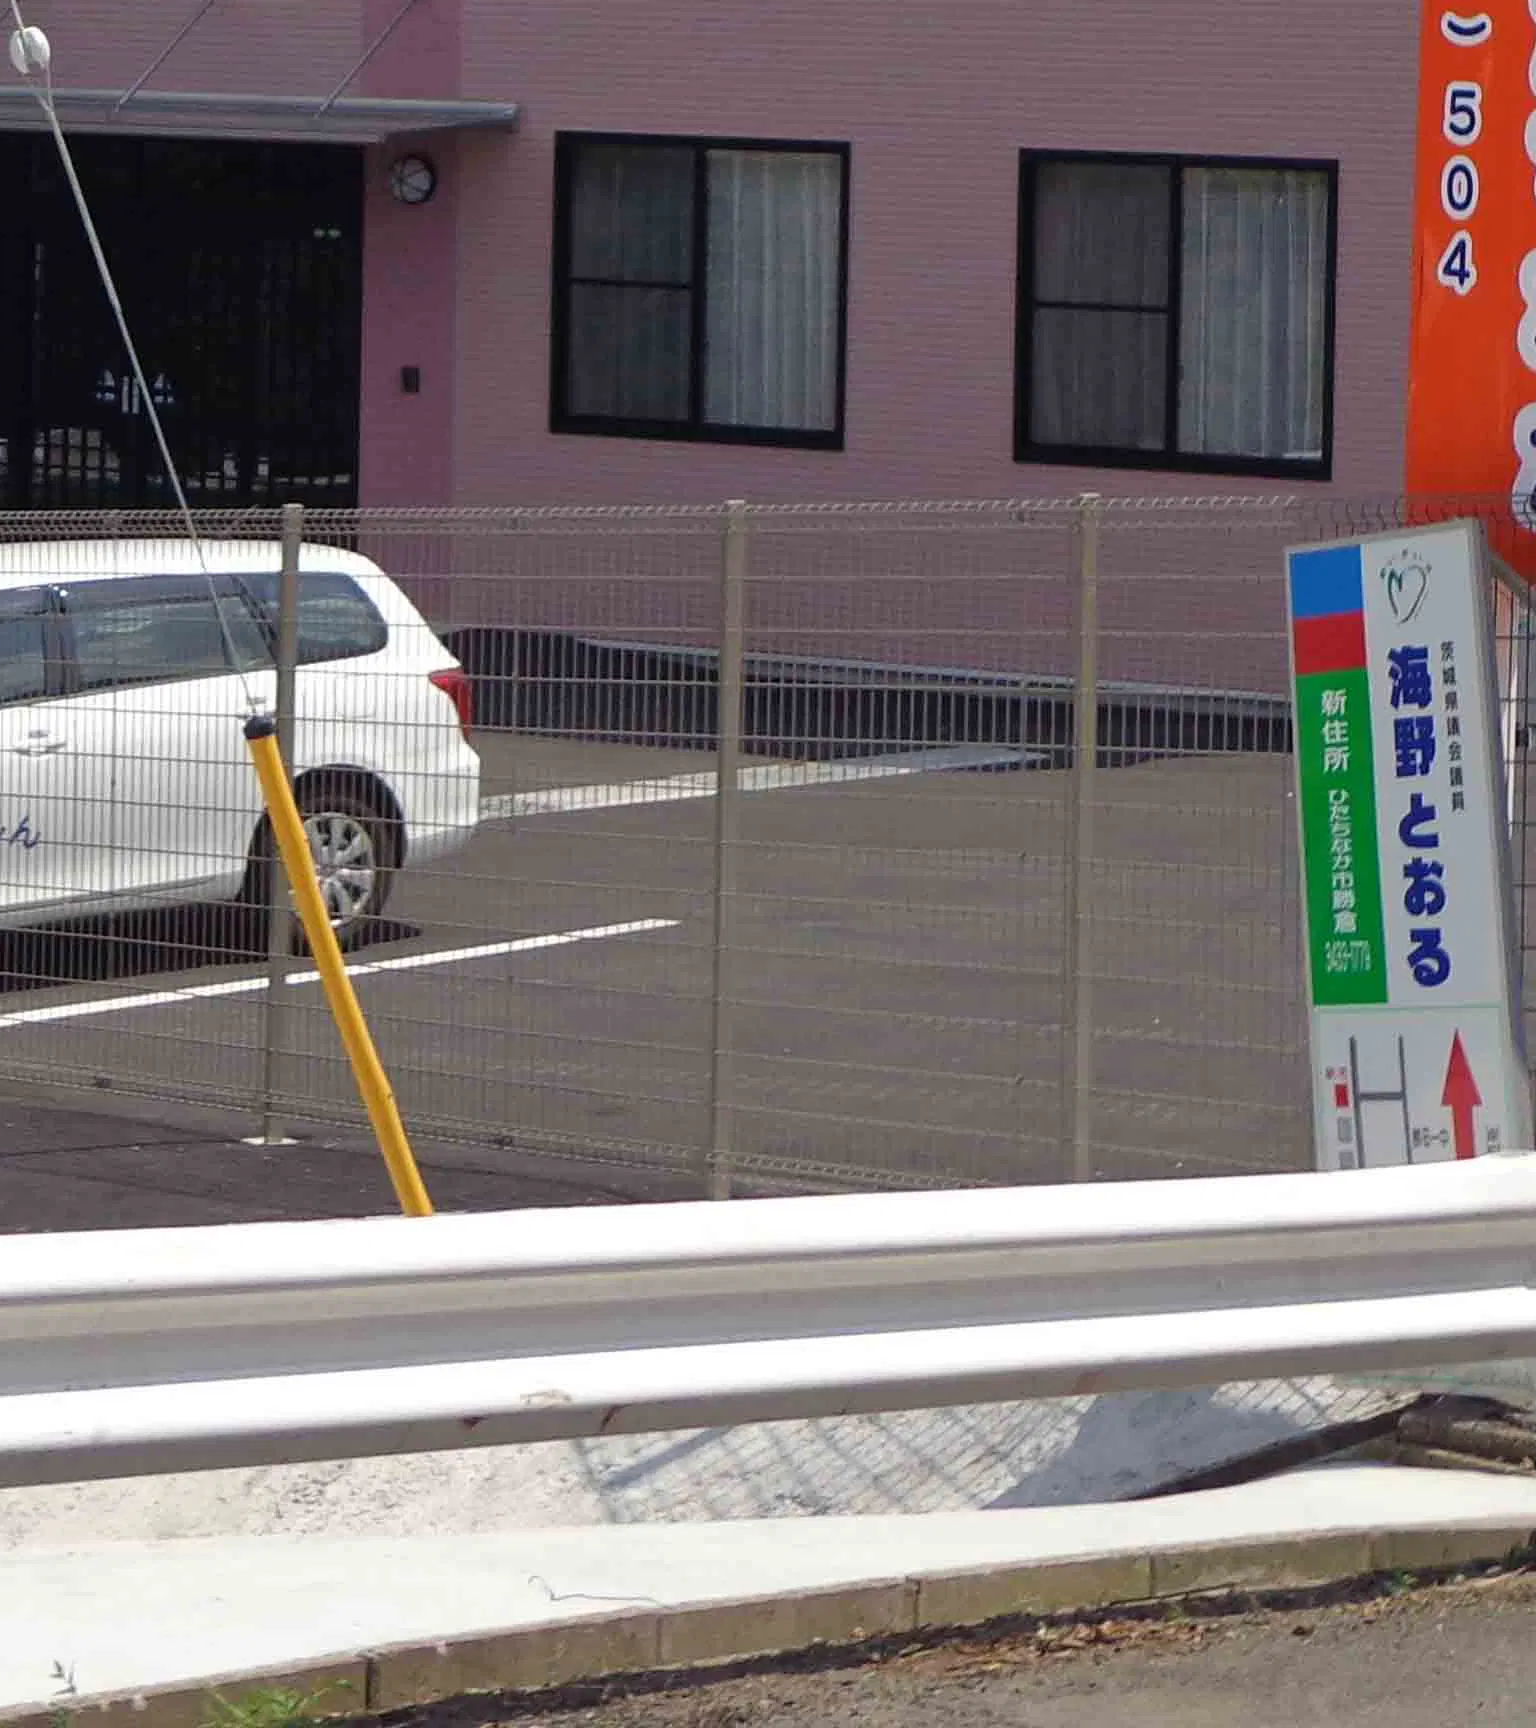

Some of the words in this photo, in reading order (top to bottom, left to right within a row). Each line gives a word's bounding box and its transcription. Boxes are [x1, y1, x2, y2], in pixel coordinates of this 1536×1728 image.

[1320, 688, 1352, 773] 新住所
[1387, 644, 1452, 989] 海野とおる
